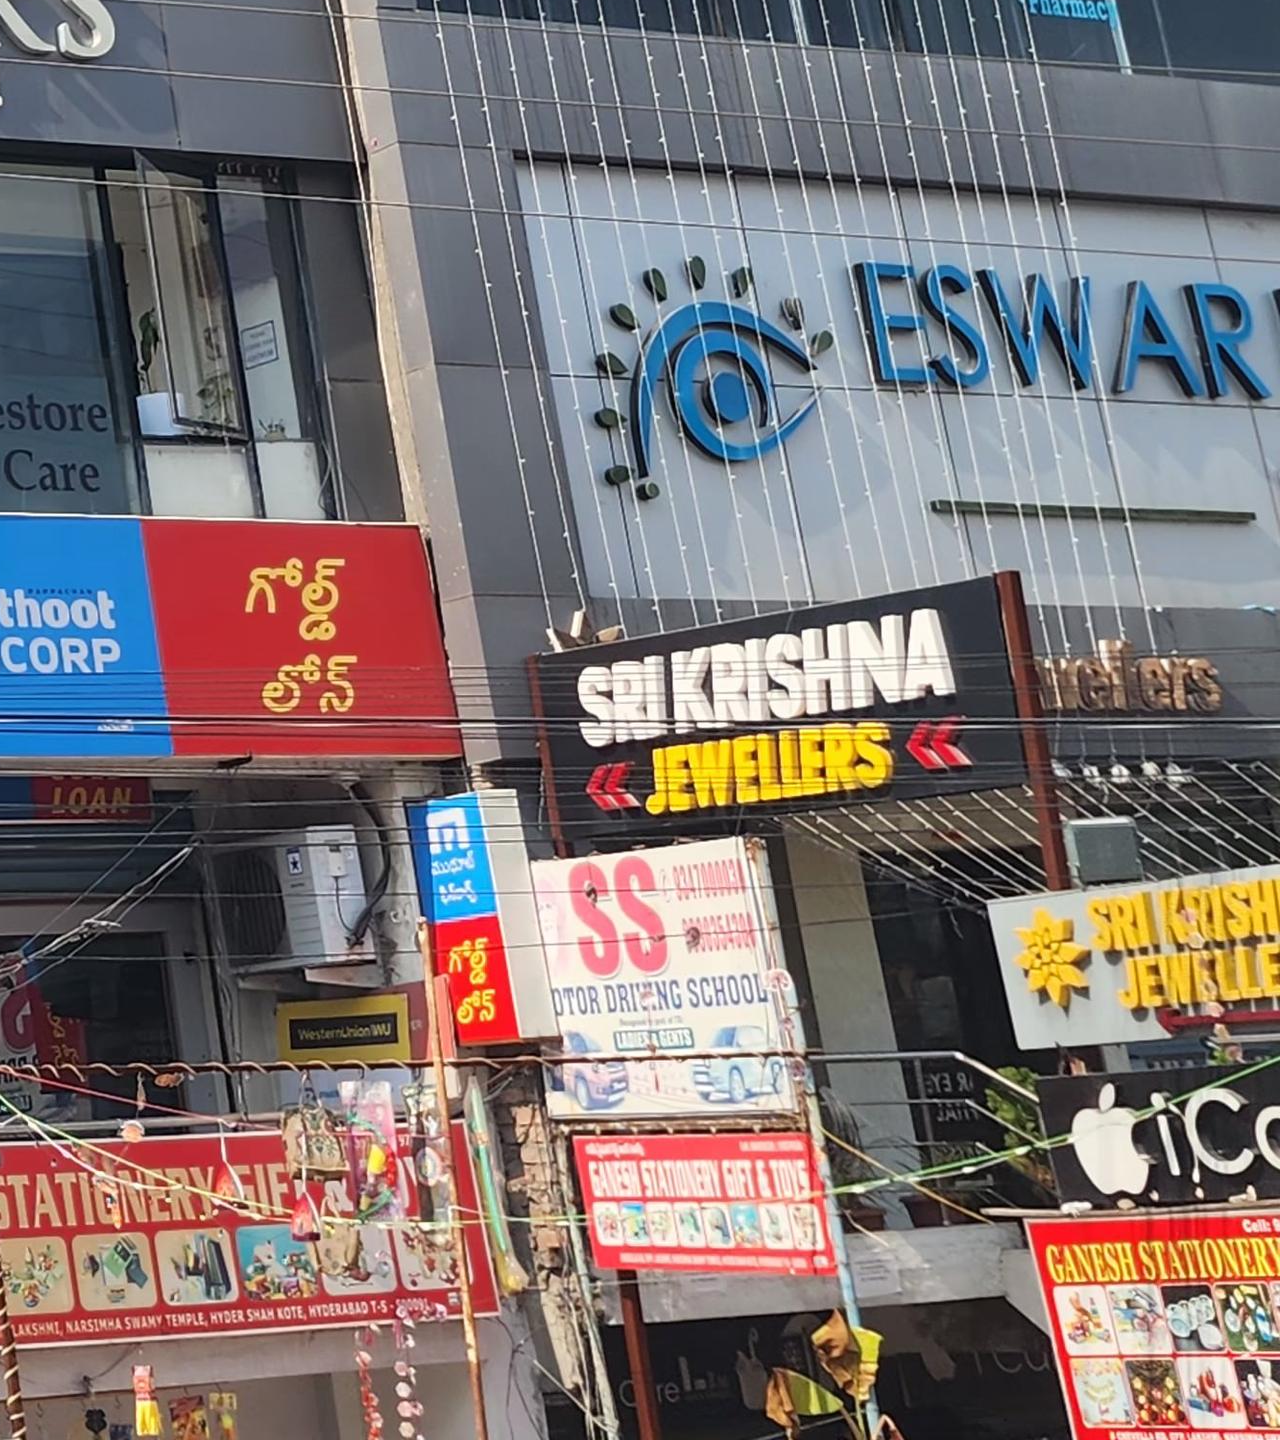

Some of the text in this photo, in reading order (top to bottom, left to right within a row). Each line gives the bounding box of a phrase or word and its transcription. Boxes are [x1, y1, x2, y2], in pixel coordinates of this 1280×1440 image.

[3, 450, 100, 493] Care
[578, 608, 957, 749] SRI KRISHNA
[646, 721, 894, 816] JEWELLERS
[52, 787, 132, 815] LOAN
[568, 856, 670, 977] SS
[1087, 892, 1151, 951] SRI
[689, 973, 769, 1009] SCHOOL
[589, 1159, 811, 1201] GANESH STATIONERY GIFT TOYS
[1046, 1241, 1138, 1283] GANESH
[66, 1301, 368, 1334] NARSIMHA SWAMY HYDER SHAH HYDERABAD
